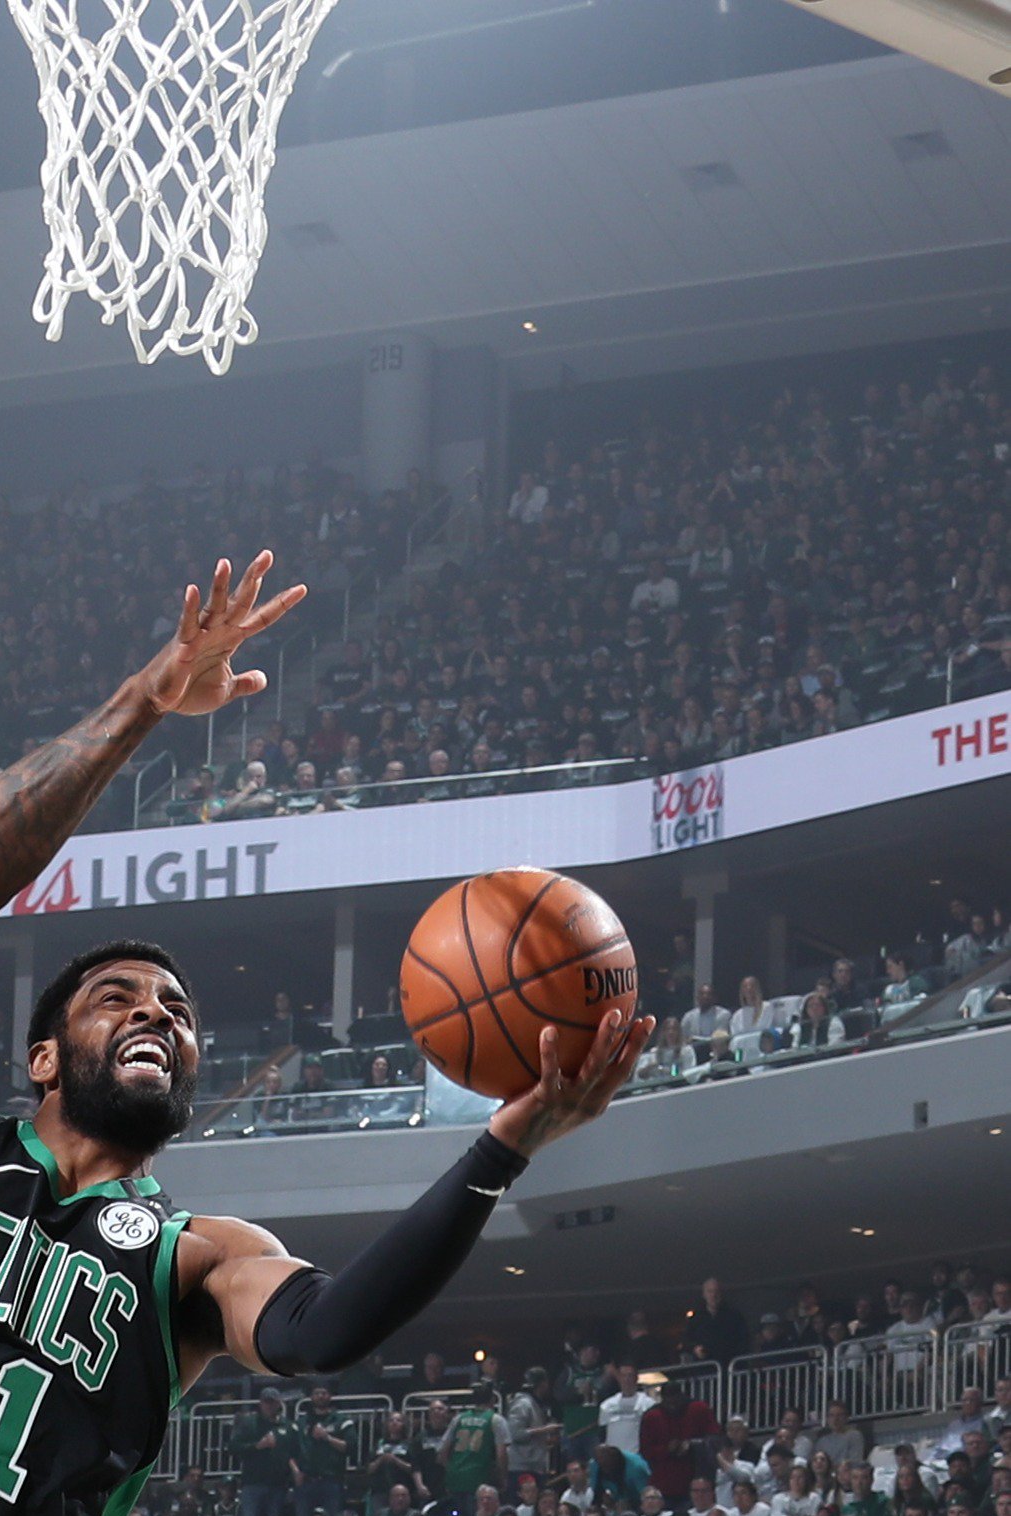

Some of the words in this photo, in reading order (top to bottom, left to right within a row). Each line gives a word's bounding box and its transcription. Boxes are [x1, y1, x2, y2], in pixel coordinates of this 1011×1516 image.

[932, 713, 1009, 766] THE
[657, 811, 719, 849] LIGHT
[91, 841, 280, 910] LIGHT
